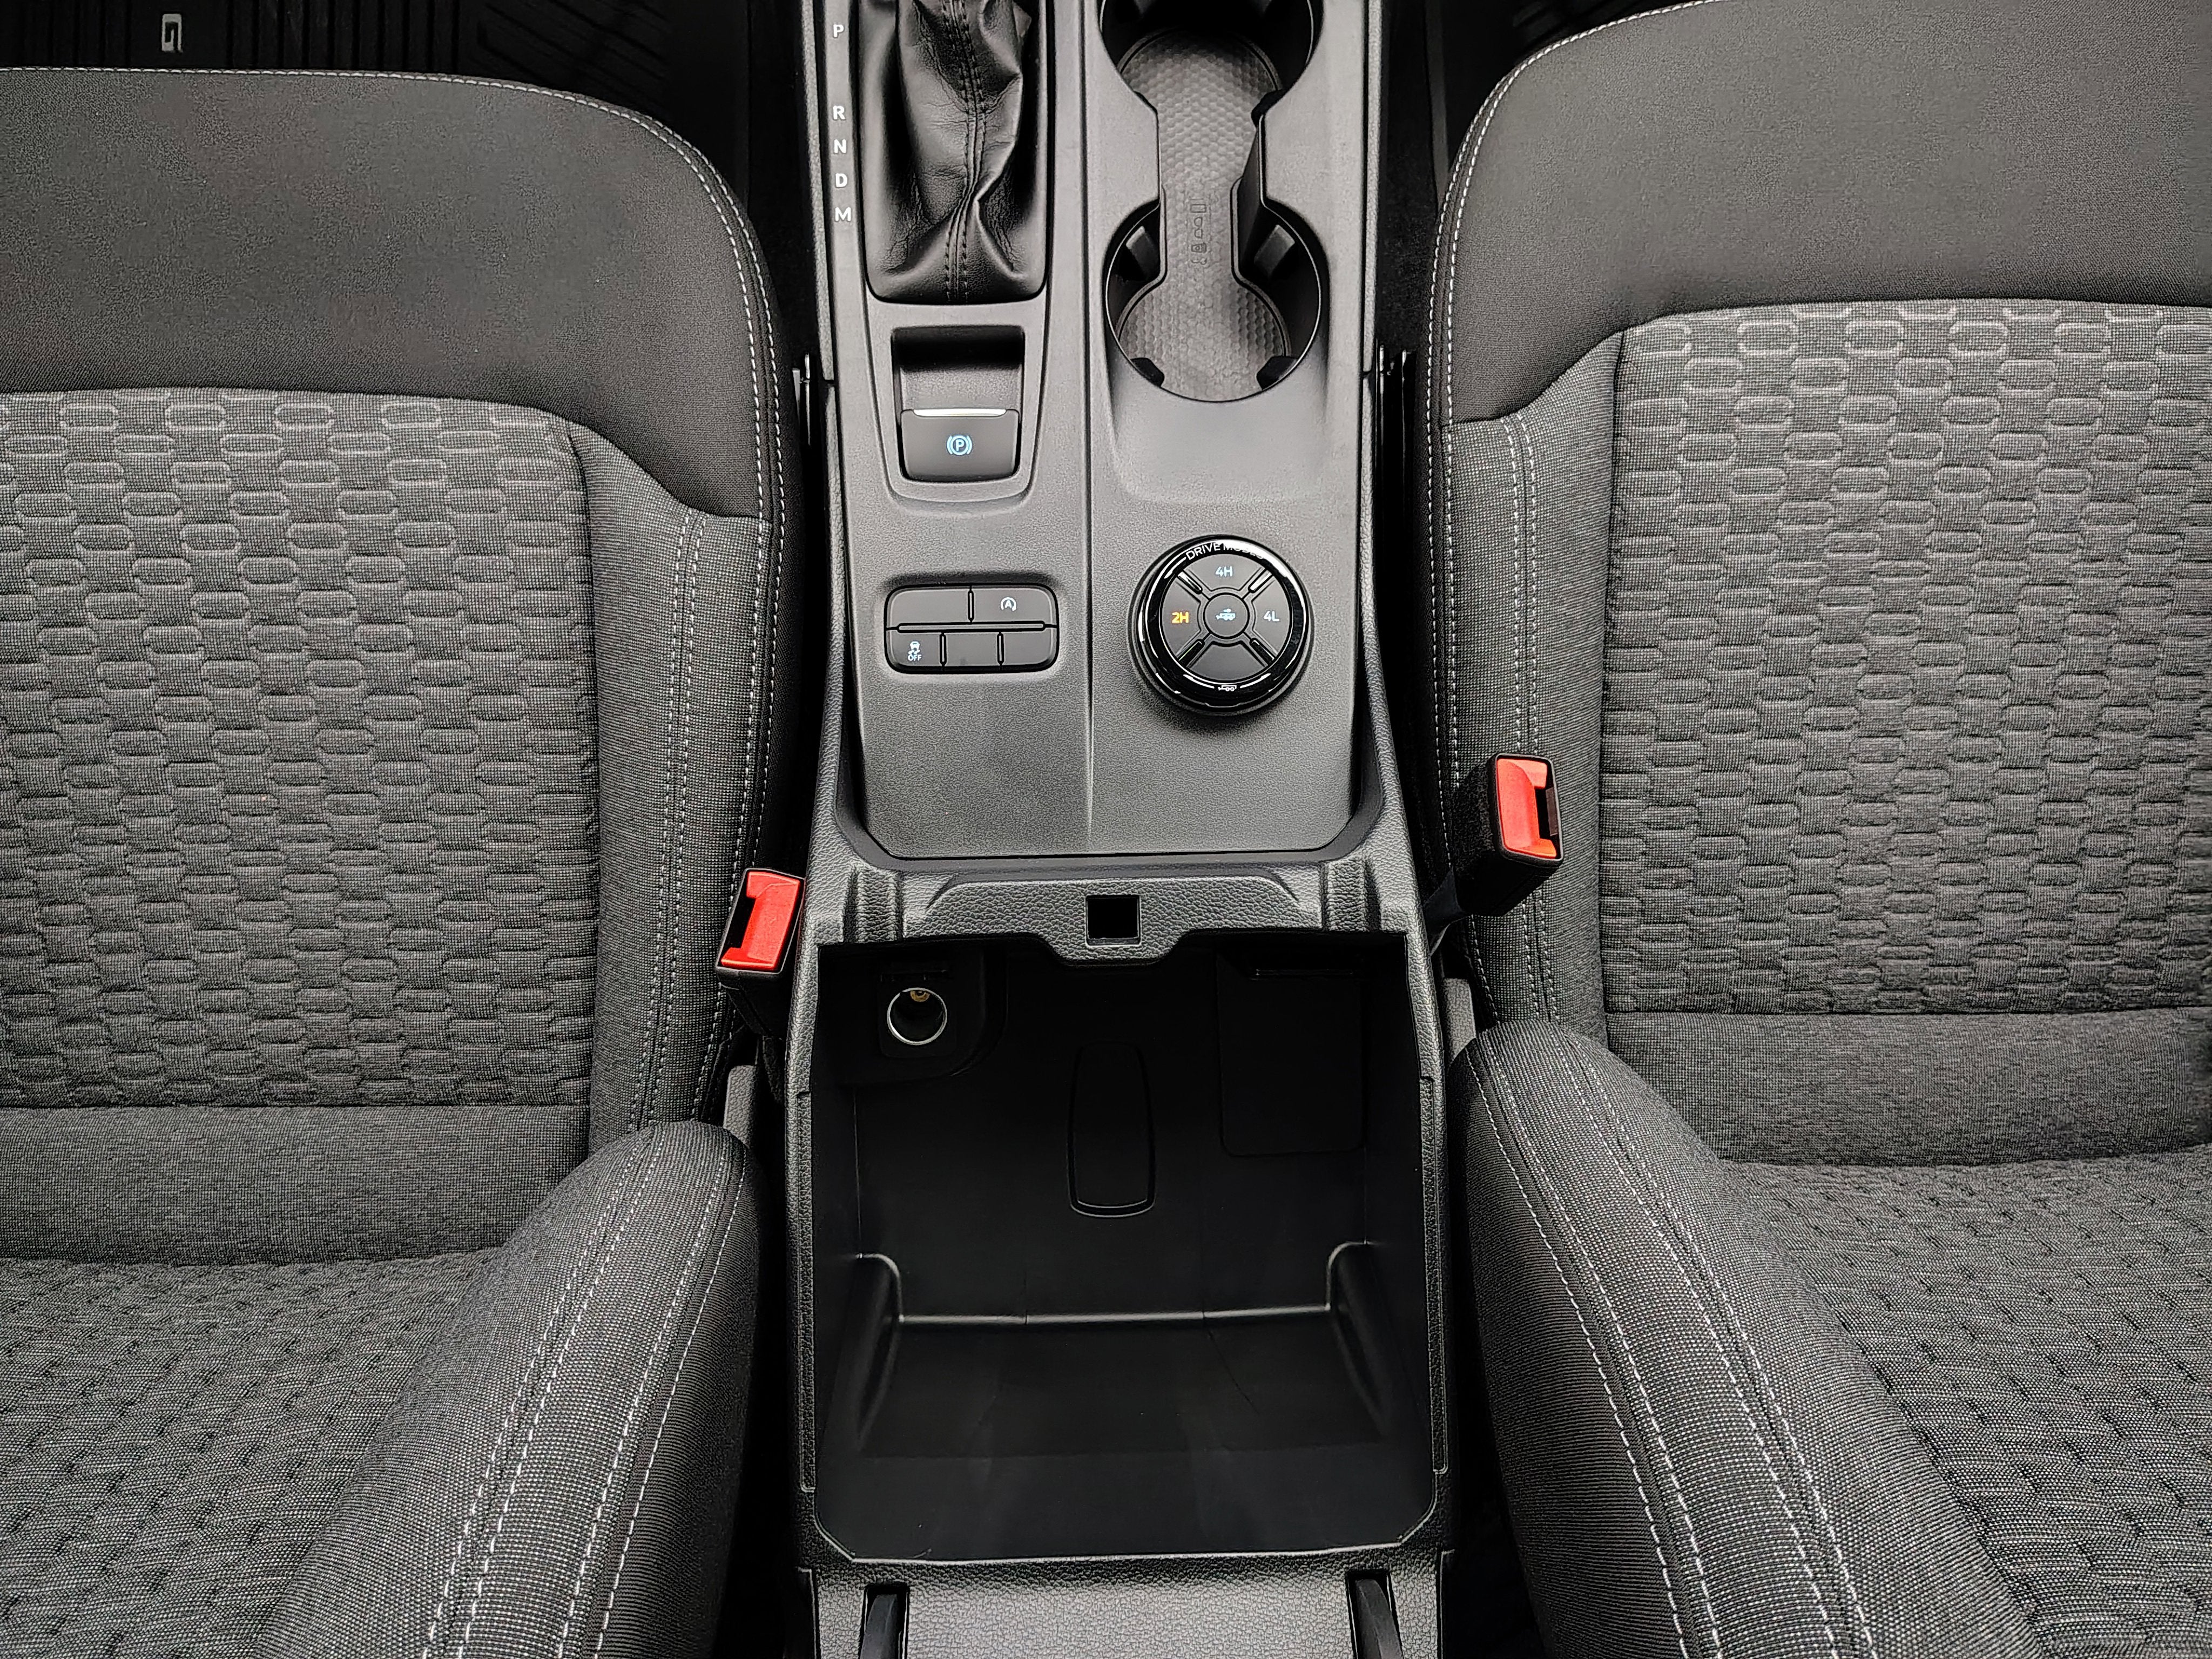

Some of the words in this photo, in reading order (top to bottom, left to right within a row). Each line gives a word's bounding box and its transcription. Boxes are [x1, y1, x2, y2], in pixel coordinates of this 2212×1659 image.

[833, 24, 845, 38] P
[833, 105, 846, 120] R
[833, 139, 847, 154] N
[835, 173, 848, 188] D
[834, 207, 852, 222] M
[1186, 543, 1220, 560] DRIVE
[1216, 566, 1232, 577] 4H
[1171, 612, 1189, 623] 2H
[1263, 611, 1280, 622] 4L
